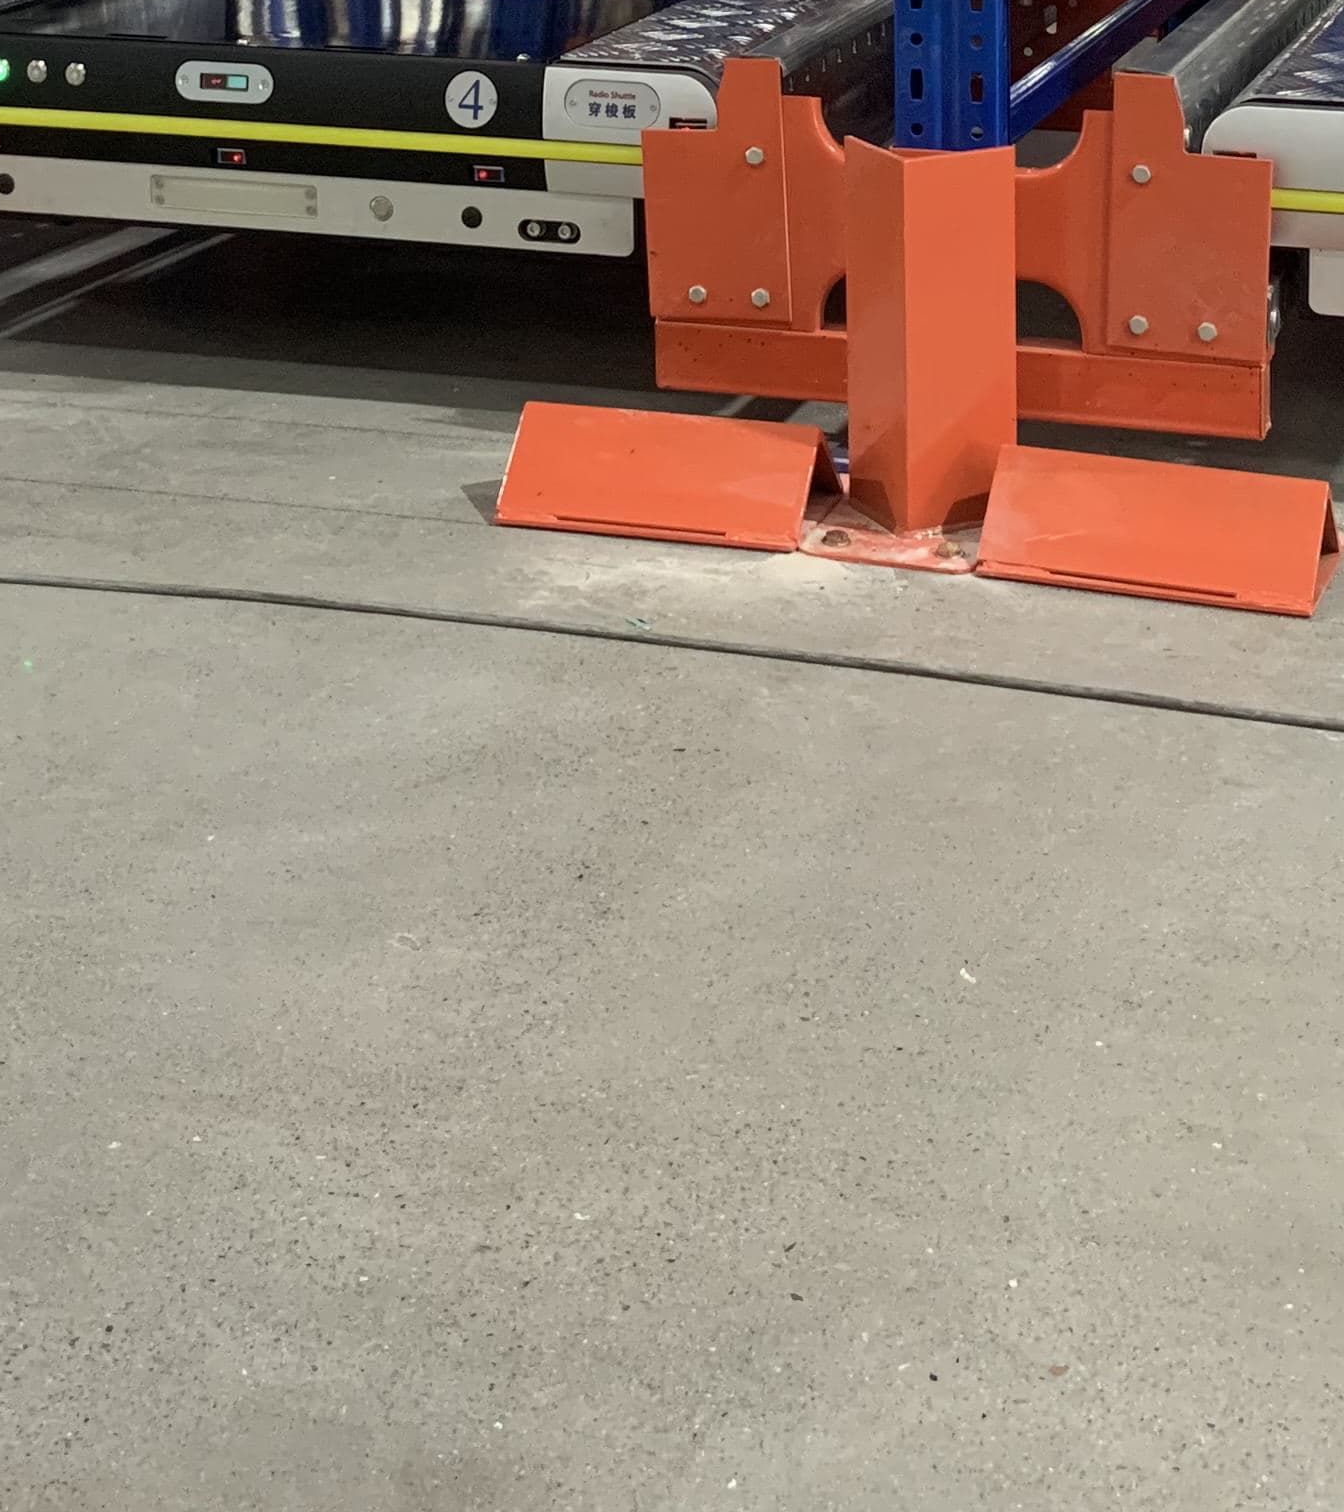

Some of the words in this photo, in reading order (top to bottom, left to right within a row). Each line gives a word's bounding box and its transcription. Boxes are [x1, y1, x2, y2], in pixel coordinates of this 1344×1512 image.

[458, 80, 484, 120] 4
[589, 90, 609, 99] Radio
[611, 91, 636, 100] Shuttle
